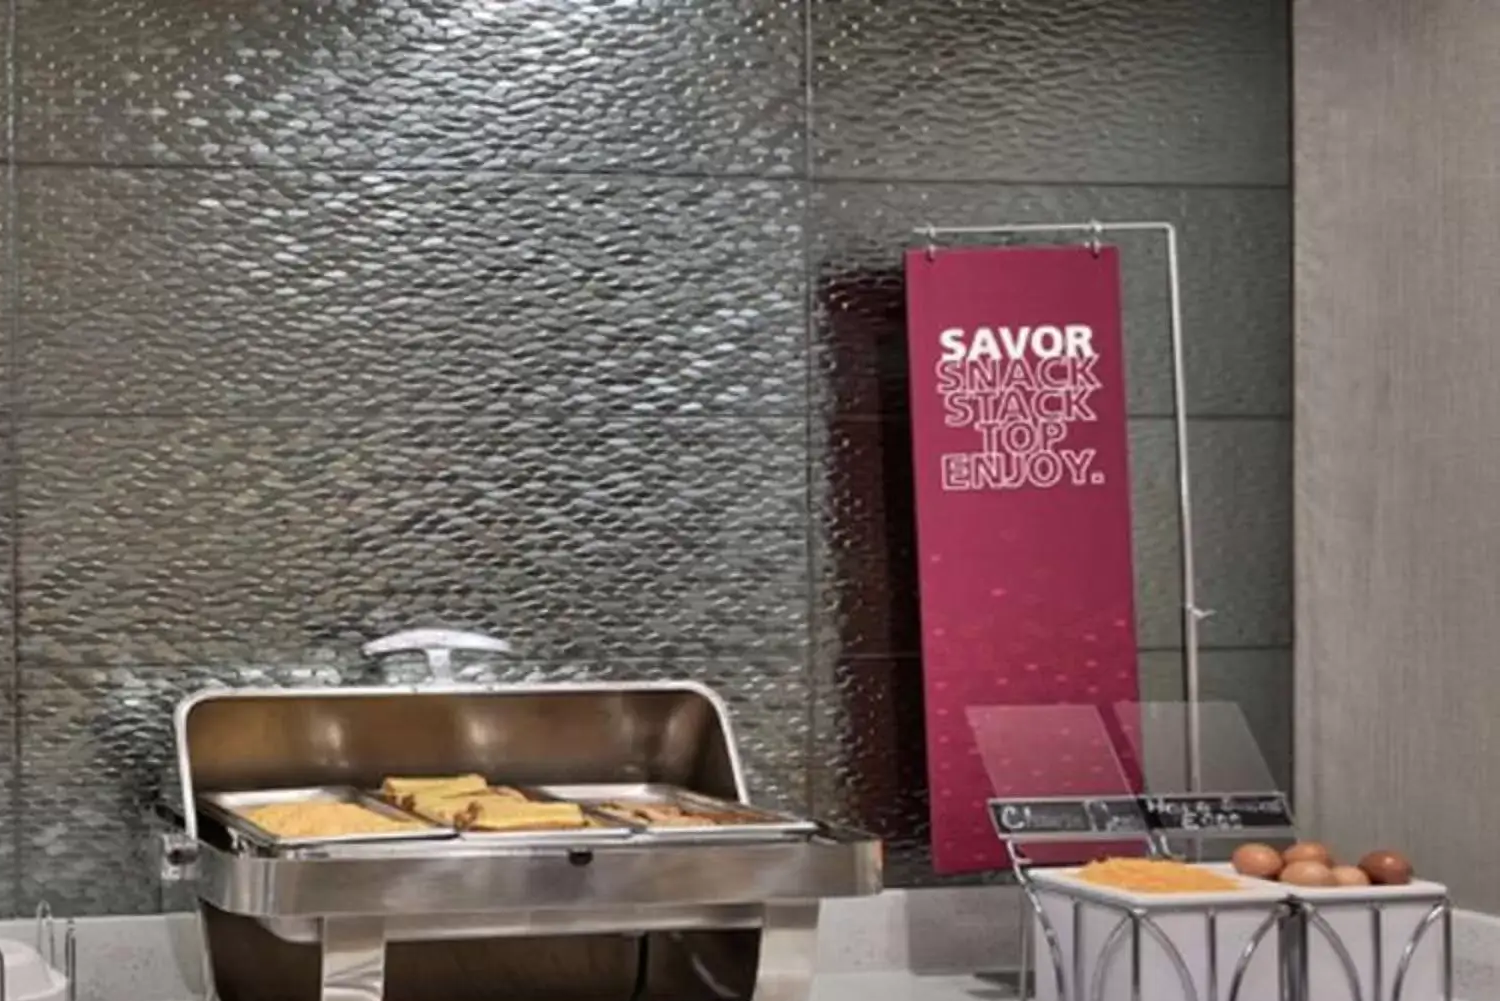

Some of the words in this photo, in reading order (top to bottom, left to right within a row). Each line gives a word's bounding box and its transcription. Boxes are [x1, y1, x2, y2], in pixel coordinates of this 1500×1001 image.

[940, 324, 1093, 361] SAVOR
[935, 353, 1102, 394] SNACK
[944, 387, 1097, 426] STACK
[974, 419, 1067, 454] TOP
[941, 449, 1105, 490] ENJOY.
